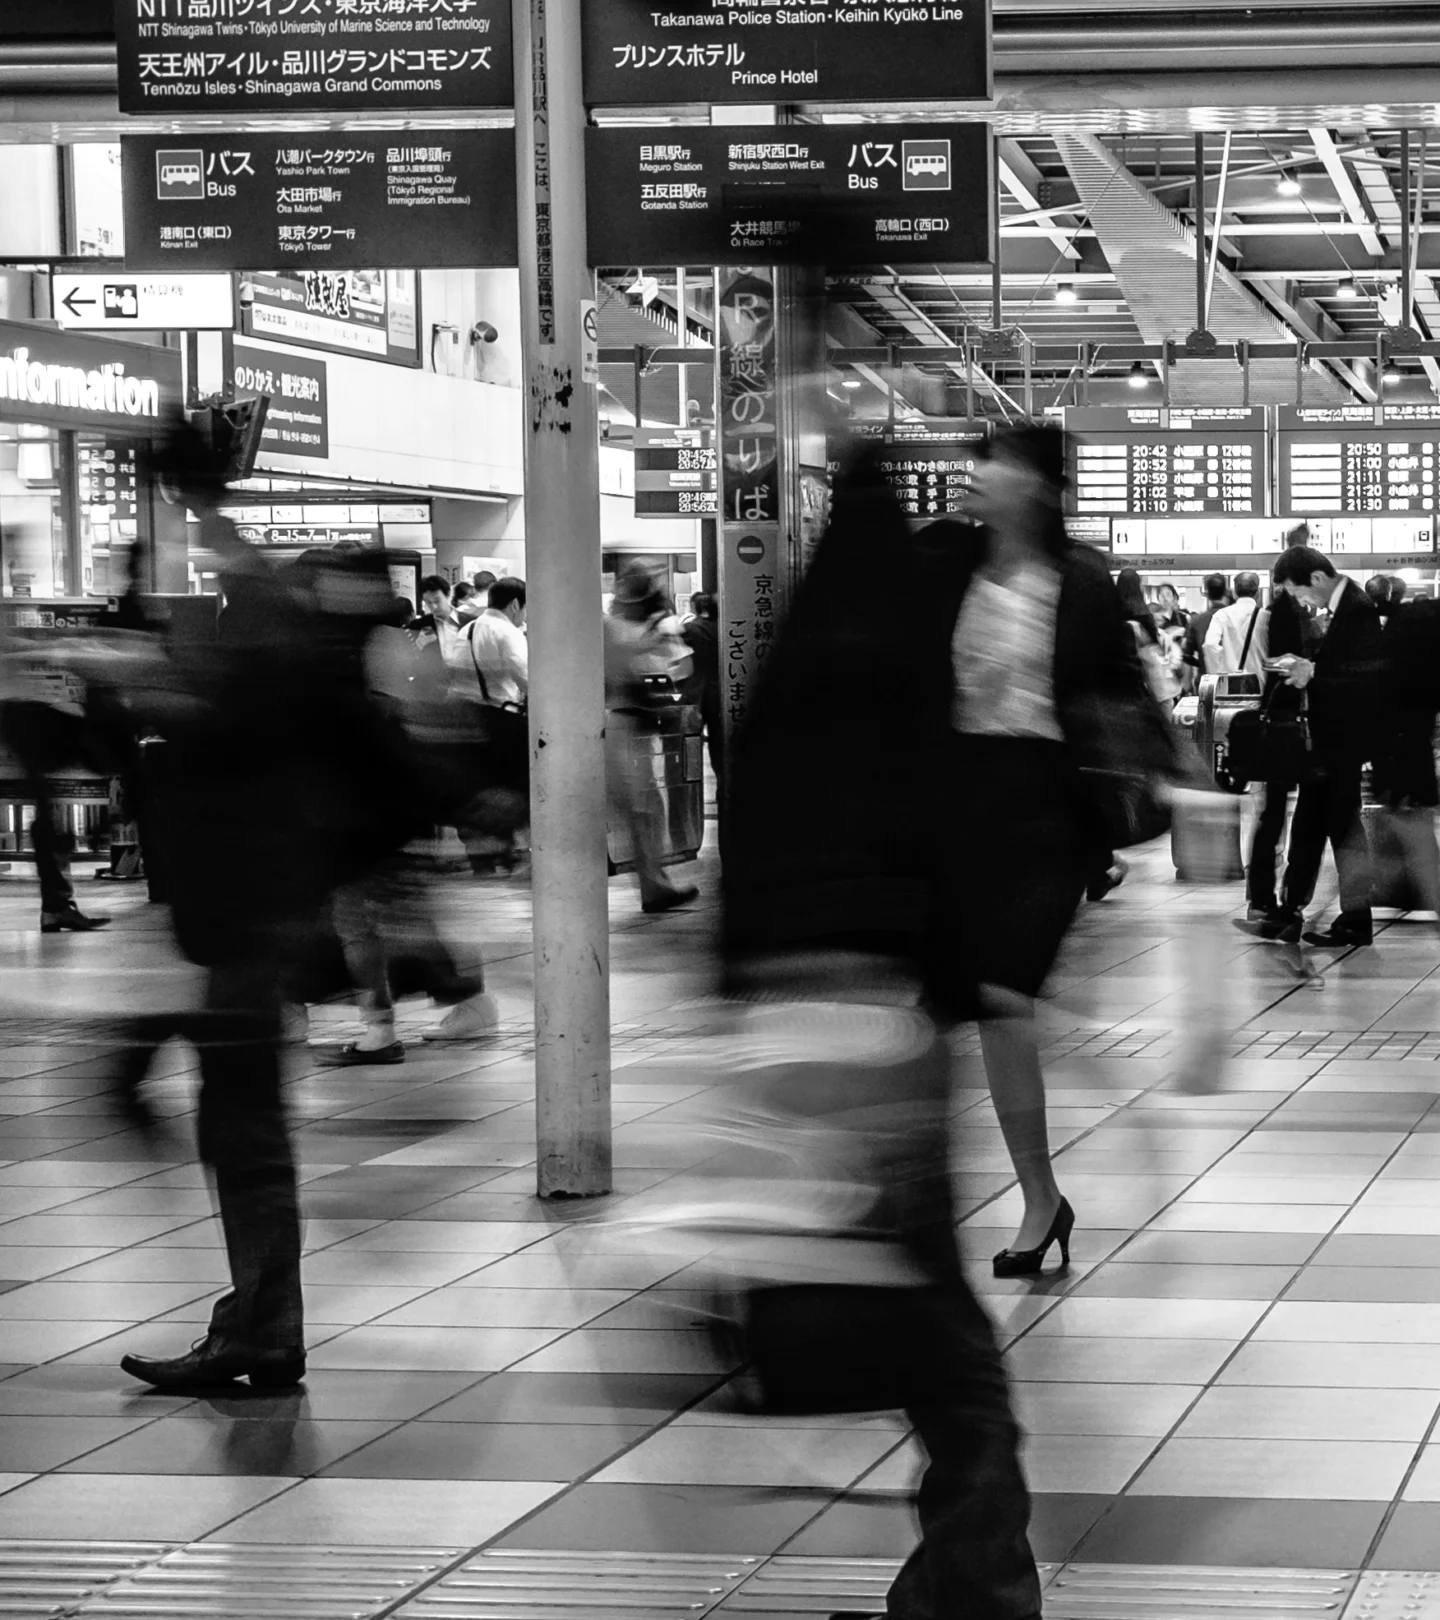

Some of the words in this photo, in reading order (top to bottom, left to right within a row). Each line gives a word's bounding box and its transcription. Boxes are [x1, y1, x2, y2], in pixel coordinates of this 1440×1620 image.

[651, 12, 725, 26] Takanawa
[729, 10, 772, 25] Police
[932, 6, 964, 21] Line
[138, 23, 159, 37] NTT
[161, 22, 214, 39] Shinagawa
[280, 19, 327, 36] University
[328, 19, 339, 33] of
[340, 18, 373, 32] Marine
[375, 18, 413, 32] Science
[415, 17, 433, 31] and
[435, 16, 490, 33] Technology
[612, 43, 746, 68] プリンスホテル
[731, 71, 777, 84] Prince
[781, 69, 819, 84] Hotel
[325, 78, 368, 92] Grand
[371, 77, 442, 91] Commons
[640, 145, 691, 161] 目黒駅行
[728, 143, 809, 159] 新宿駅西口行
[848, 141, 898, 168] バス
[206, 150, 256, 176] バス
[640, 162, 672, 173] Meguro
[673, 161, 703, 171] Station
[728, 161, 761, 172] Shinjuku
[762, 160, 788, 170] Station
[789, 160, 809, 170] West
[810, 160, 825, 170] Exit
[275, 166, 303, 176] Yashio
[305, 166, 326, 175] Park
[327, 166, 350, 175] Town
[387, 175, 432, 186] Shinagawa
[434, 175, 457, 185] Quay
[848, 174, 879, 189] Bus
[207, 181, 237, 197] Bus
[276, 186, 342, 202] 大田市場行
[418, 185, 454, 196] Regional
[641, 183, 708, 199] 五反田駅行
[387, 195, 436, 207] Immigration
[438, 195, 471, 206] Bureau)
[641, 201, 677, 211] Gotanda
[679, 200, 709, 210] Station
[294, 204, 323, 213] Market
[278, 225, 356, 241] 東京タワー行
[914, 233, 928, 241] Exit
[185, 240, 199, 249] Exit
[306, 242, 332, 251] Tower
[727, 262, 772, 520] R線のりば
[1132, 445, 1168, 457] 20:42
[1347, 443, 1382, 456] 20:50
[1132, 458, 1168, 471] 20:52
[1347, 457, 1382, 470] 21:00
[1132, 472, 1168, 484] 20:59
[1347, 470, 1381, 483] 21:11
[1132, 486, 1168, 498] 21:02
[1347, 484, 1382, 497] 21:20
[1132, 500, 1168, 512] 21:10
[1347, 498, 1382, 511] 21:30
